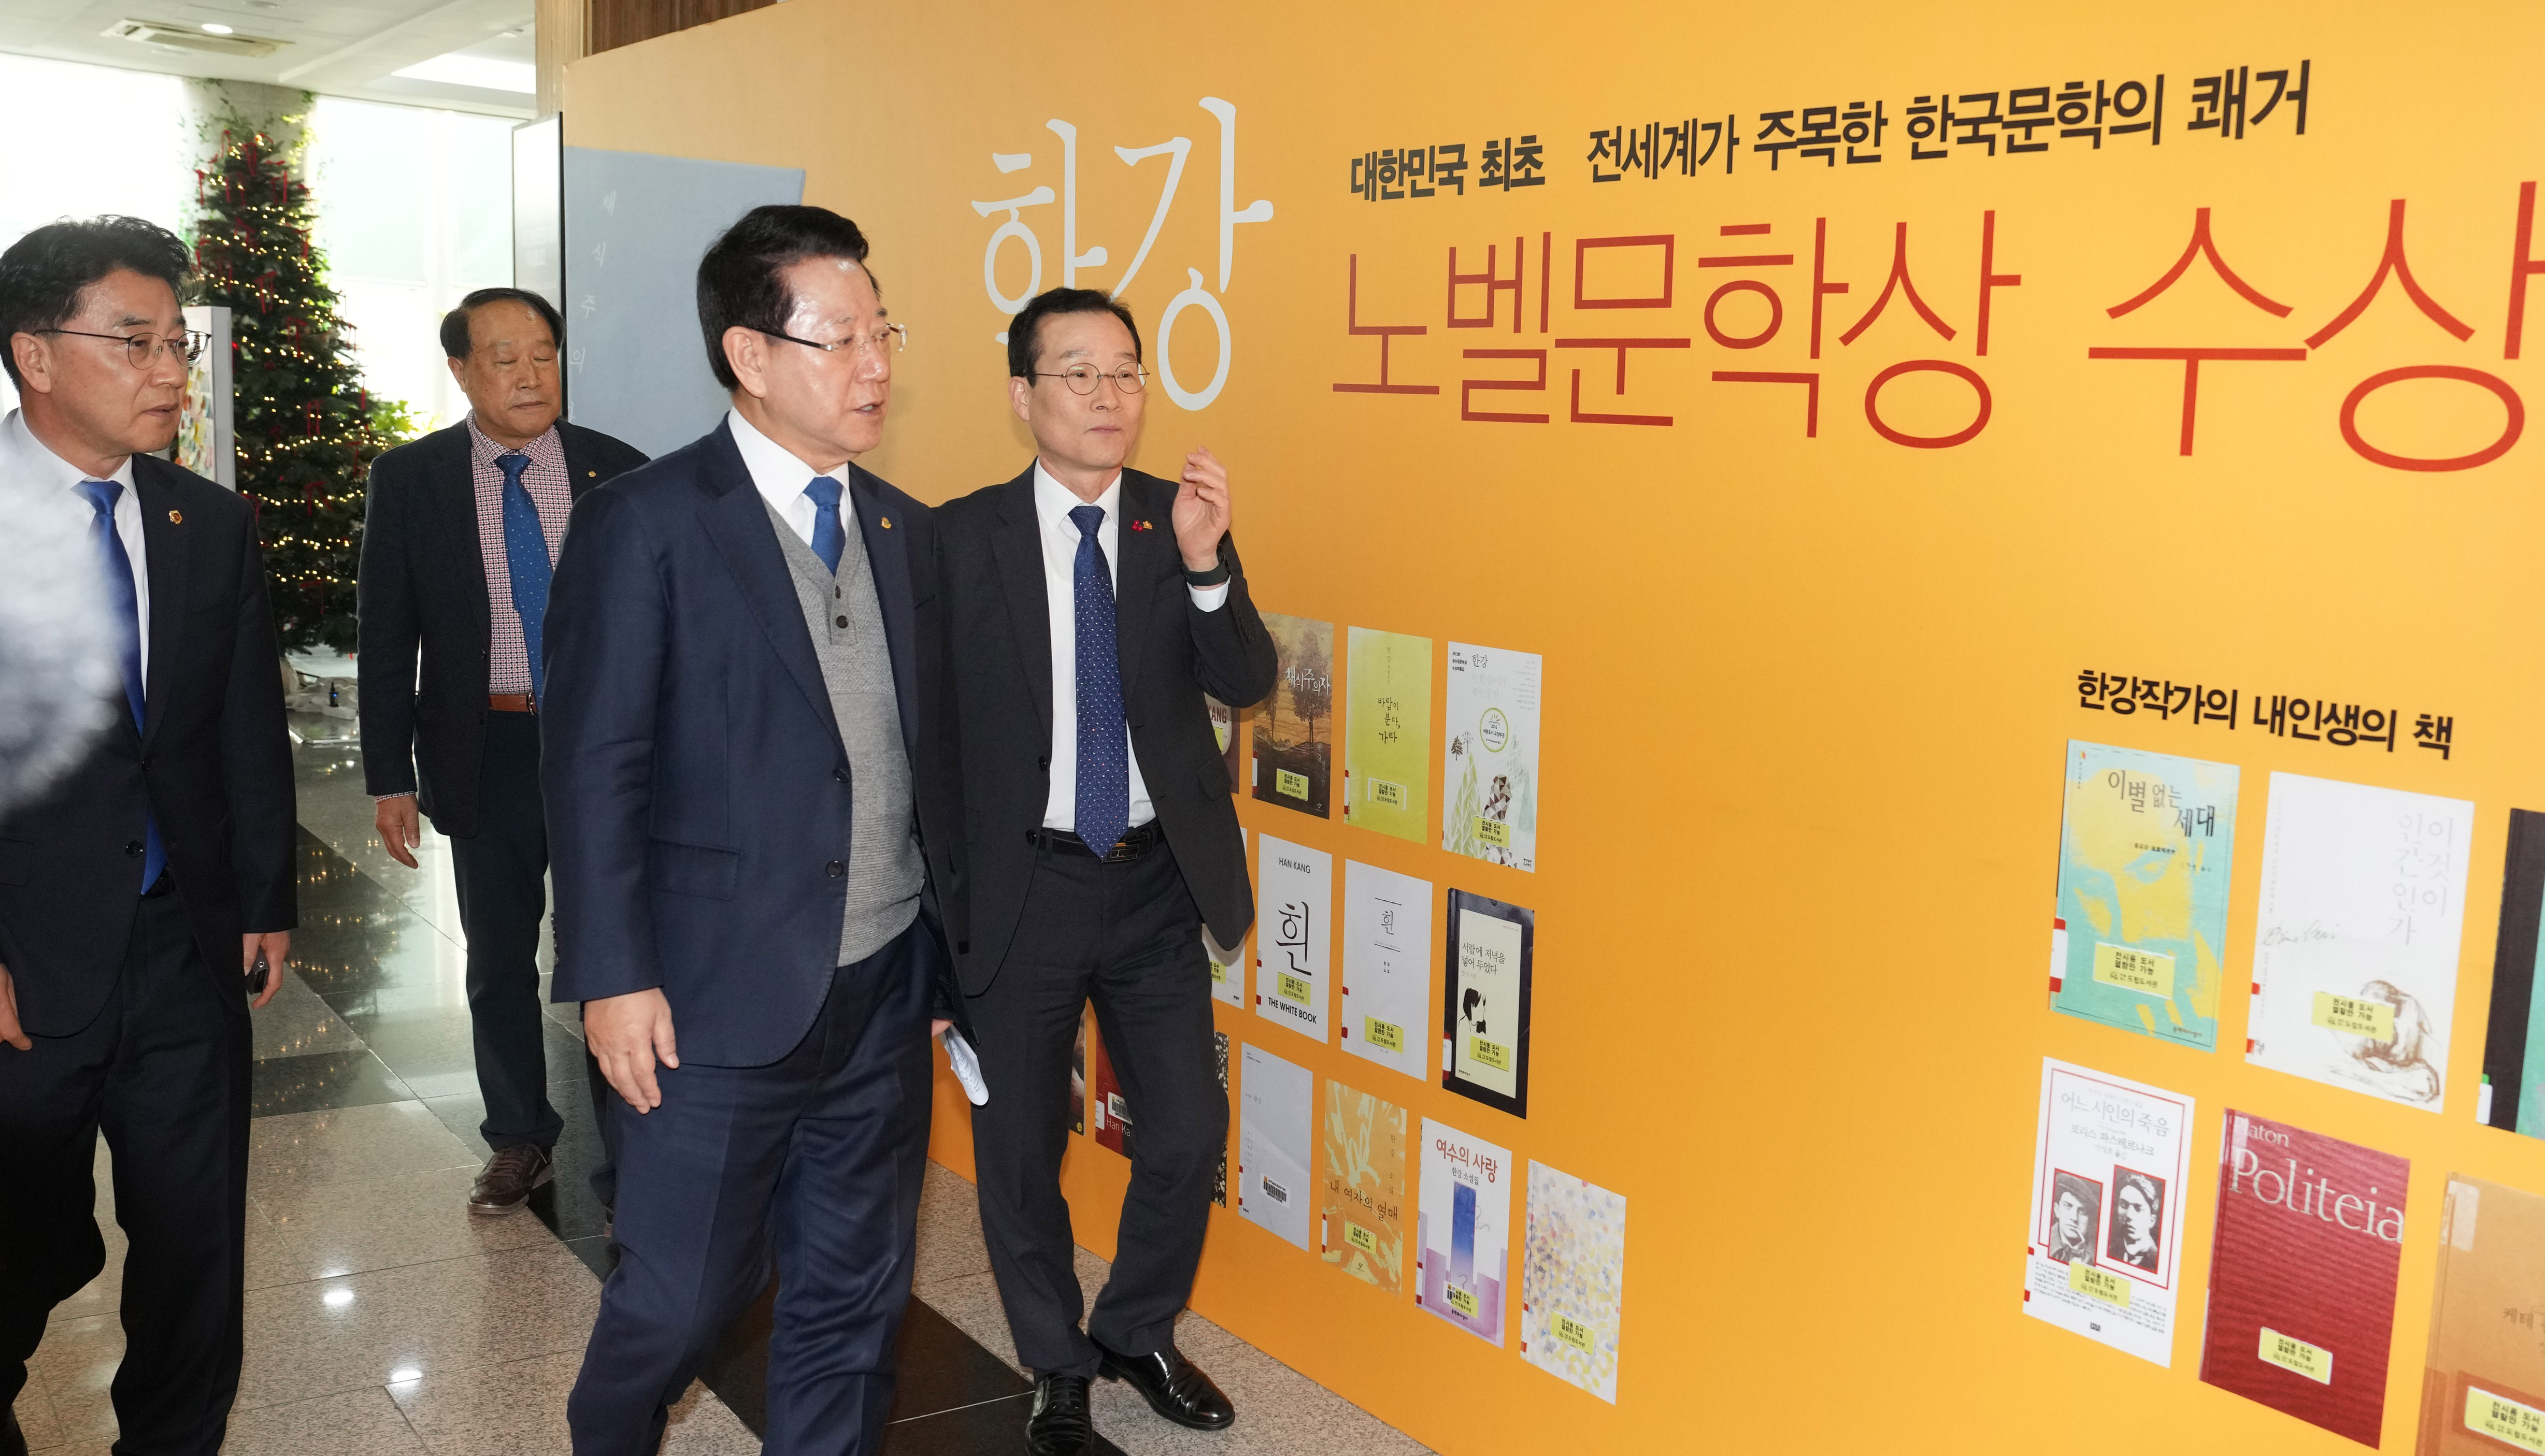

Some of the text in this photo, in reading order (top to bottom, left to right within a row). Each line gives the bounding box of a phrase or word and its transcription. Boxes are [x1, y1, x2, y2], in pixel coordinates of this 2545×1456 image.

[1351, 60, 2310, 201] 대한민국 최초 전세계가 주목한 한국문학의 쾌거
[971, 96, 1274, 411] 한강
[1333, 181, 2545, 472] 노벨문학상 수상
[1472, 654, 1489, 668] 한강
[1284, 666, 1331, 696] 채식주의자
[1378, 697, 1398, 711] 바람이
[2078, 670, 2454, 760] 한강작가의 내인생의 책
[1384, 712, 1400, 729] 분다,
[1379, 731, 1397, 744] 가라
[2108, 770, 2147, 813] 이별
[2152, 784, 2182, 809] 없는
[2174, 805, 2215, 838] 세대
[1279, 857, 1311, 874] HAN KANG
[1381, 910, 1394, 935] 흰
[1275, 901, 1312, 976] 흰
[1462, 942, 1506, 964] 서랍에 저녁을
[2140, 957, 2155, 967] 도서
[1462, 956, 1497, 975] 넣어 두었다
[1268, 997, 1317, 1024] THE WHITE BOOK
[2358, 1003, 2374, 1013] 도서
[1107, 1115, 1120, 1132] Han
[1122, 1123, 1131, 1136] Ka
[2061, 1091, 2089, 1112] 어느
[2091, 1101, 2135, 1128] 시인의
[2138, 1112, 2170, 1137] 죽음
[2070, 1123, 2097, 1139] 보리스
[1436, 1139, 1498, 1183] 여수의 사랑
[1452, 1167, 1479, 1186] 한강 소설집
[1331, 1180, 1397, 1222] 내 여자의 열매
[2228, 1145, 2405, 1244] Politeia
[1576, 1325, 1583, 1333] 도서
[2523, 1412, 2540, 1424] 도서
